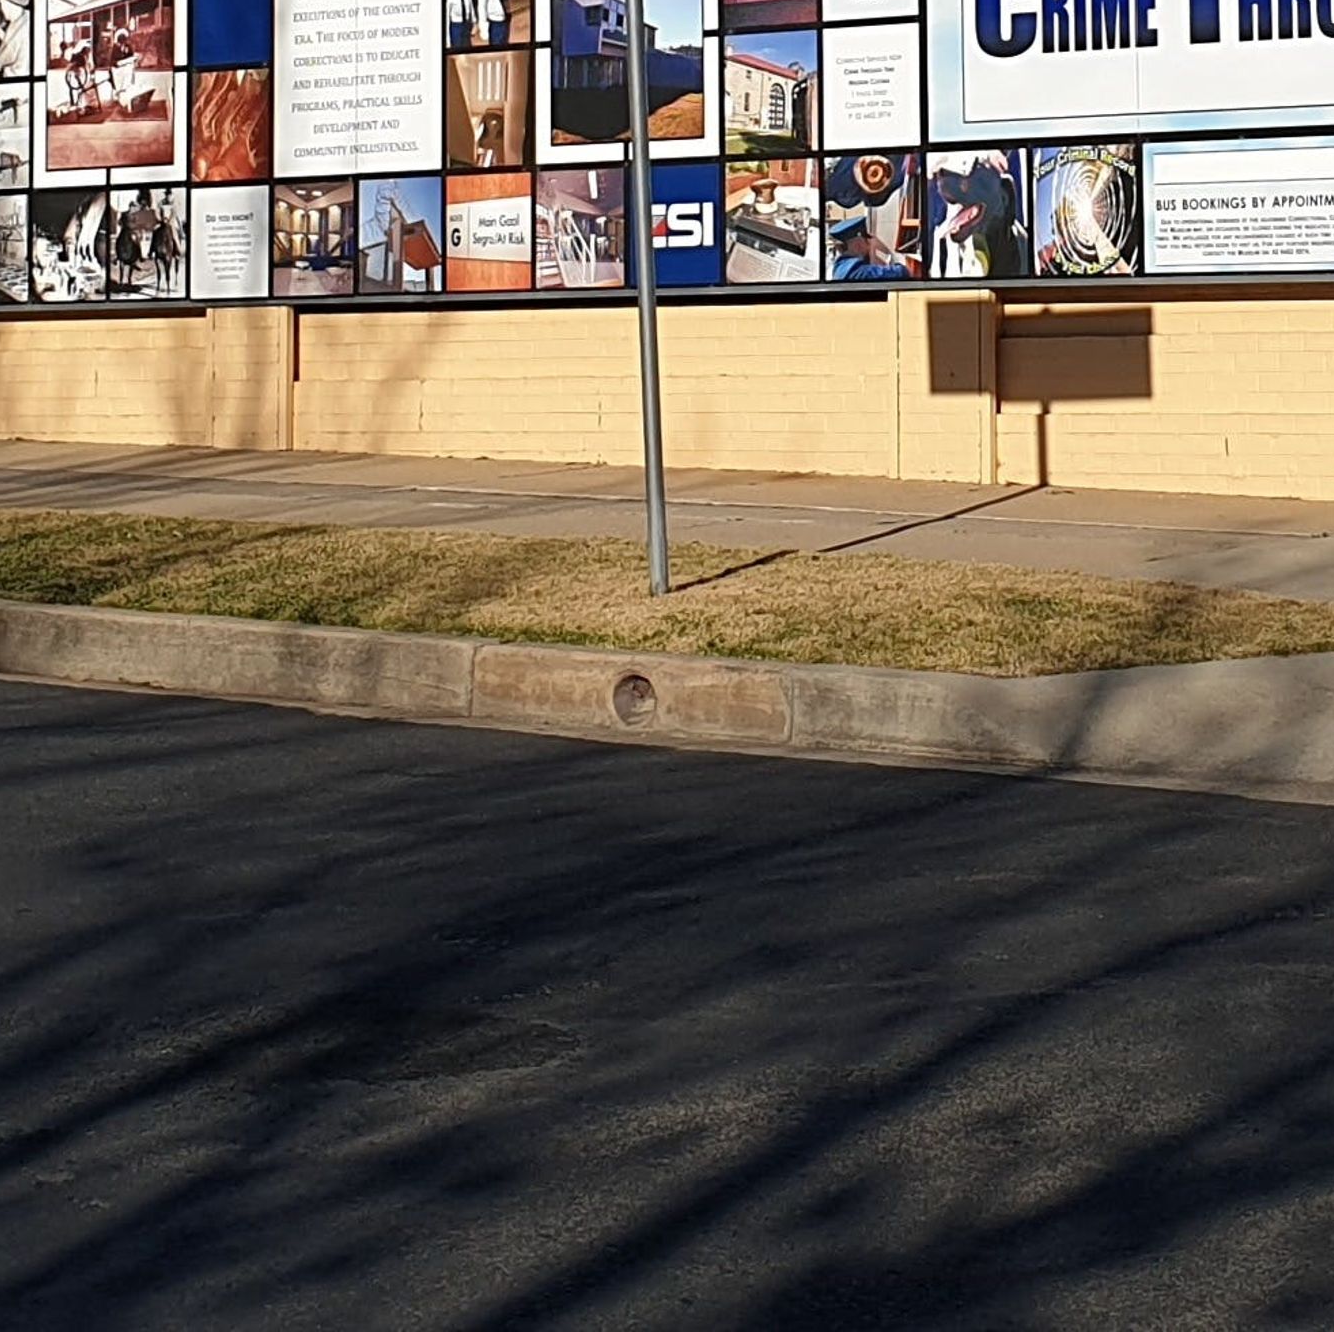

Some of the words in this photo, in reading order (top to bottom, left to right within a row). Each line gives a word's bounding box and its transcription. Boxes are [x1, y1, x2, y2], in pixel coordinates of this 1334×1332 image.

[293, 9, 346, 23] EXECUTIONS
[348, 7, 360, 18] OF
[363, 6, 379, 17] THE
[382, 3, 421, 15] CONVICT
[316, 31, 334, 43] THE
[337, 29, 365, 41] FOCUS
[367, 28, 379, 39] OF
[381, 26, 419, 38] MODERN
[293, 53, 353, 67] CORRECTIONS
[366, 51, 378, 62] TO
[380, 49, 420, 60] EDUCATE
[292, 80, 311, 90] AND
[314, 74, 376, 88] REHABILITATE
[378, 72, 421, 85] THROUGH
[291, 100, 341, 113] PROGRAMS,
[343, 97, 390, 109] PRACTICAL
[393, 94, 422, 105] SKILLS
[313, 120, 378, 134] DEVELOPMENT
[380, 119, 400, 129] AND
[293, 145, 348, 158] COMMUNITY
[1057, 147, 1098, 167] Criminal
[1100, 149, 1136, 177] Record
[1156, 198, 1177, 211] BUS
[1182, 196, 1246, 210] BOOKINGS
[1251, 195, 1267, 208] BY
[451, 228, 462, 247] G
